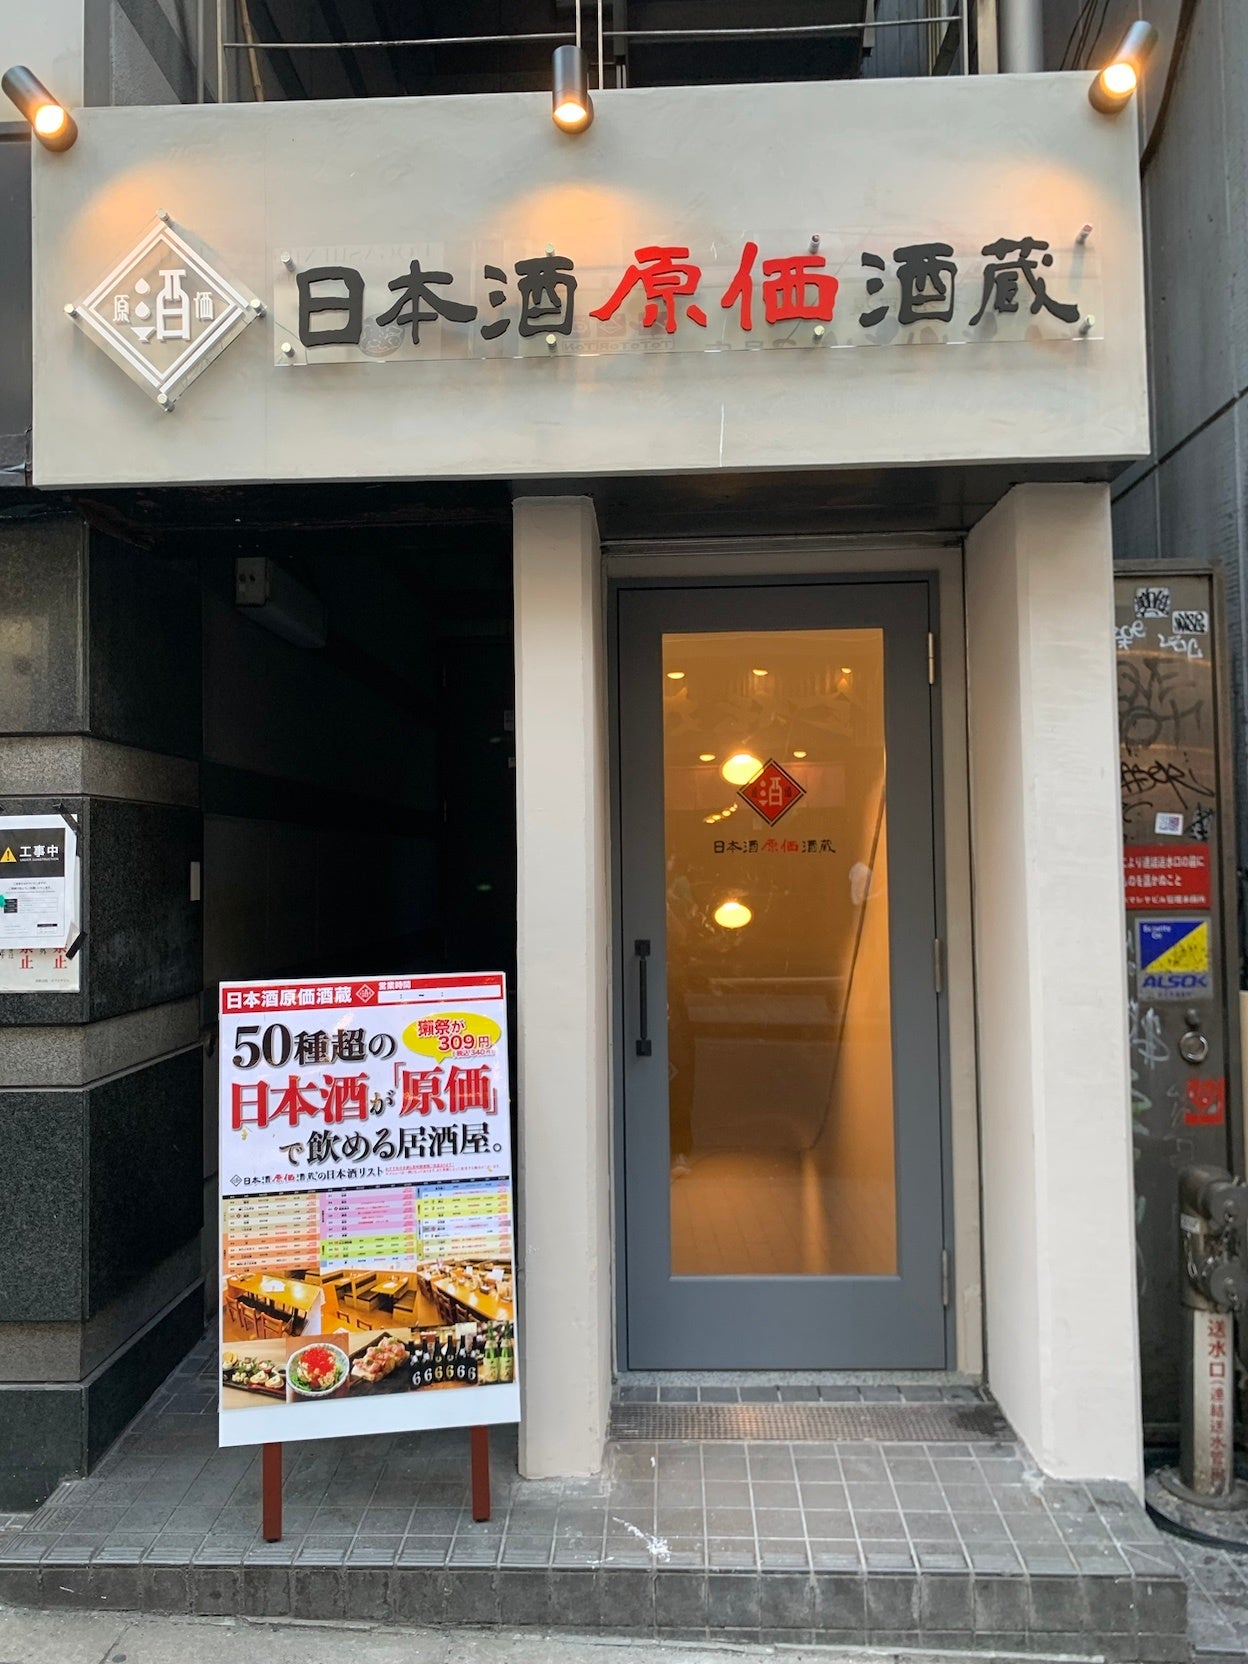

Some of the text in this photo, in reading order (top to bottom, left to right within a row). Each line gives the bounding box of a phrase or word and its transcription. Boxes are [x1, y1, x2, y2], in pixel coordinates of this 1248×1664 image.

[297, 237, 1081, 348] 日本酒原価酒蔵
[19, 844, 59, 858] 工事中
[713, 839, 836, 853] 日本酒原価酒蔵
[378, 981, 411, 991] 営業時間
[1141, 974, 1208, 989] ALSOK
[226, 986, 353, 1010] 日本酒原価酒蔵
[232, 1023, 397, 1070] 50種超の
[438, 1035, 491, 1051] 309円
[231, 1062, 497, 1130] 日本酒が「原価」
[279, 1122, 502, 1165] で飲める居酒屋。
[243, 1167, 383, 1186] 日本酒原価酒蔵の日本酒リスト
